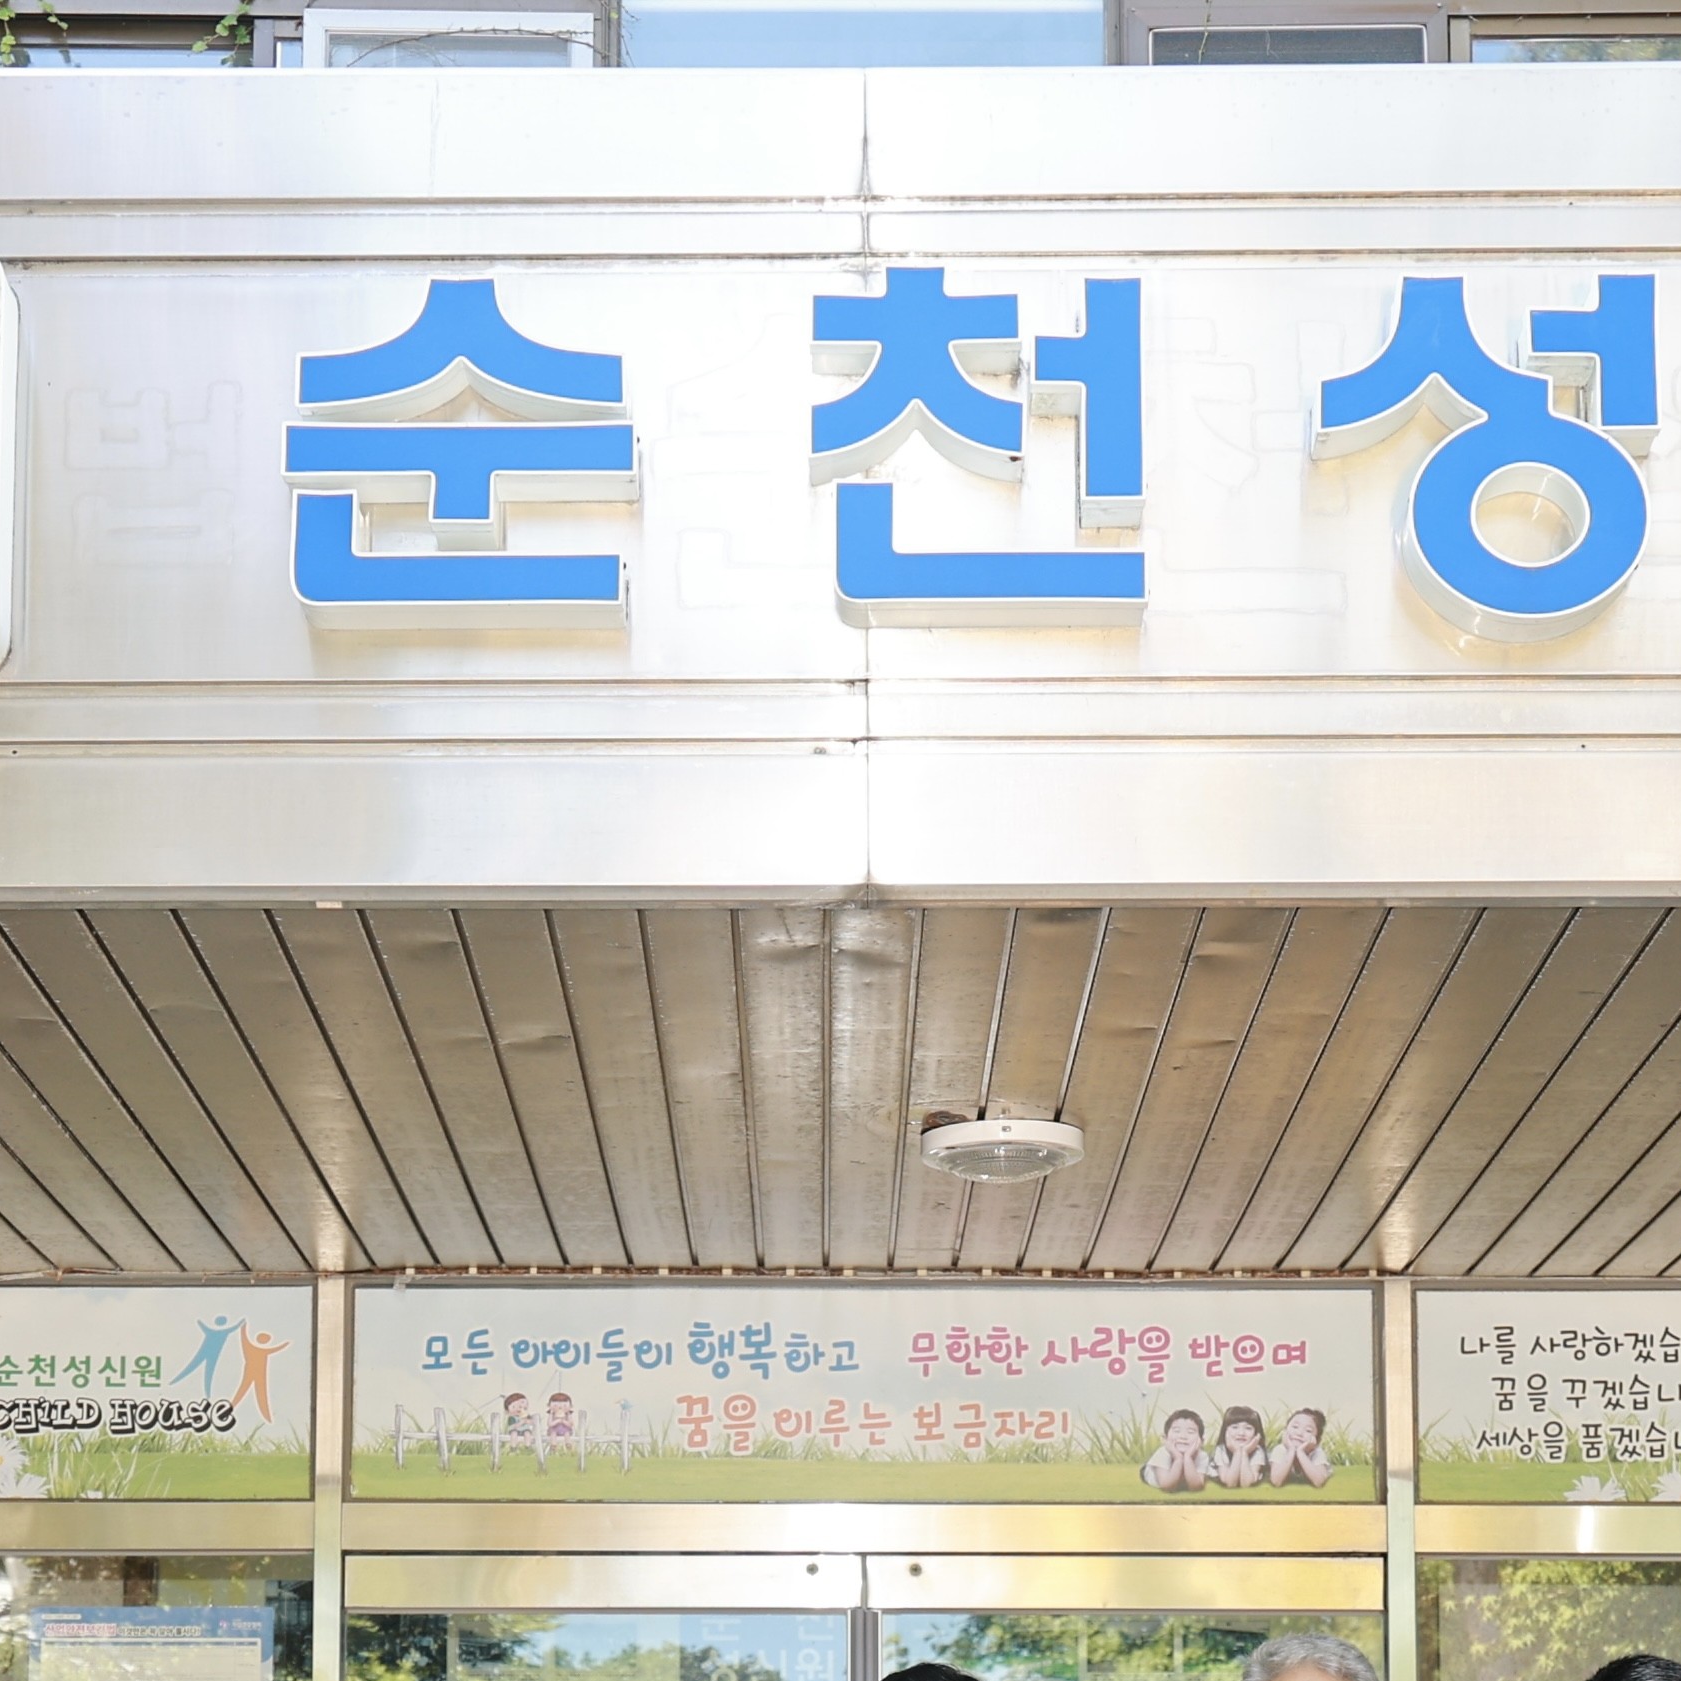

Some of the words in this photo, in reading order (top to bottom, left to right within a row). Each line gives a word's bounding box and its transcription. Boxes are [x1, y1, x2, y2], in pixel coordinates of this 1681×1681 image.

[421, 1328, 496, 1375] 모든
[510, 1328, 674, 1381] 아이들이
[687, 1321, 860, 1378] 행복하고
[907, 1327, 1030, 1369] 무한한
[1040, 1324, 1171, 1385] 사랑을
[1187, 1331, 1310, 1375] 받으며
[1459, 1327, 1516, 1361] 나를
[1493, 1374, 1547, 1410] 꿈을
[675, 1393, 755, 1453] 꿈을
[773, 1406, 893, 1450] 이루는
[913, 1407, 1071, 1450] 보금자리
[1475, 1421, 1567, 1460] 세상을
